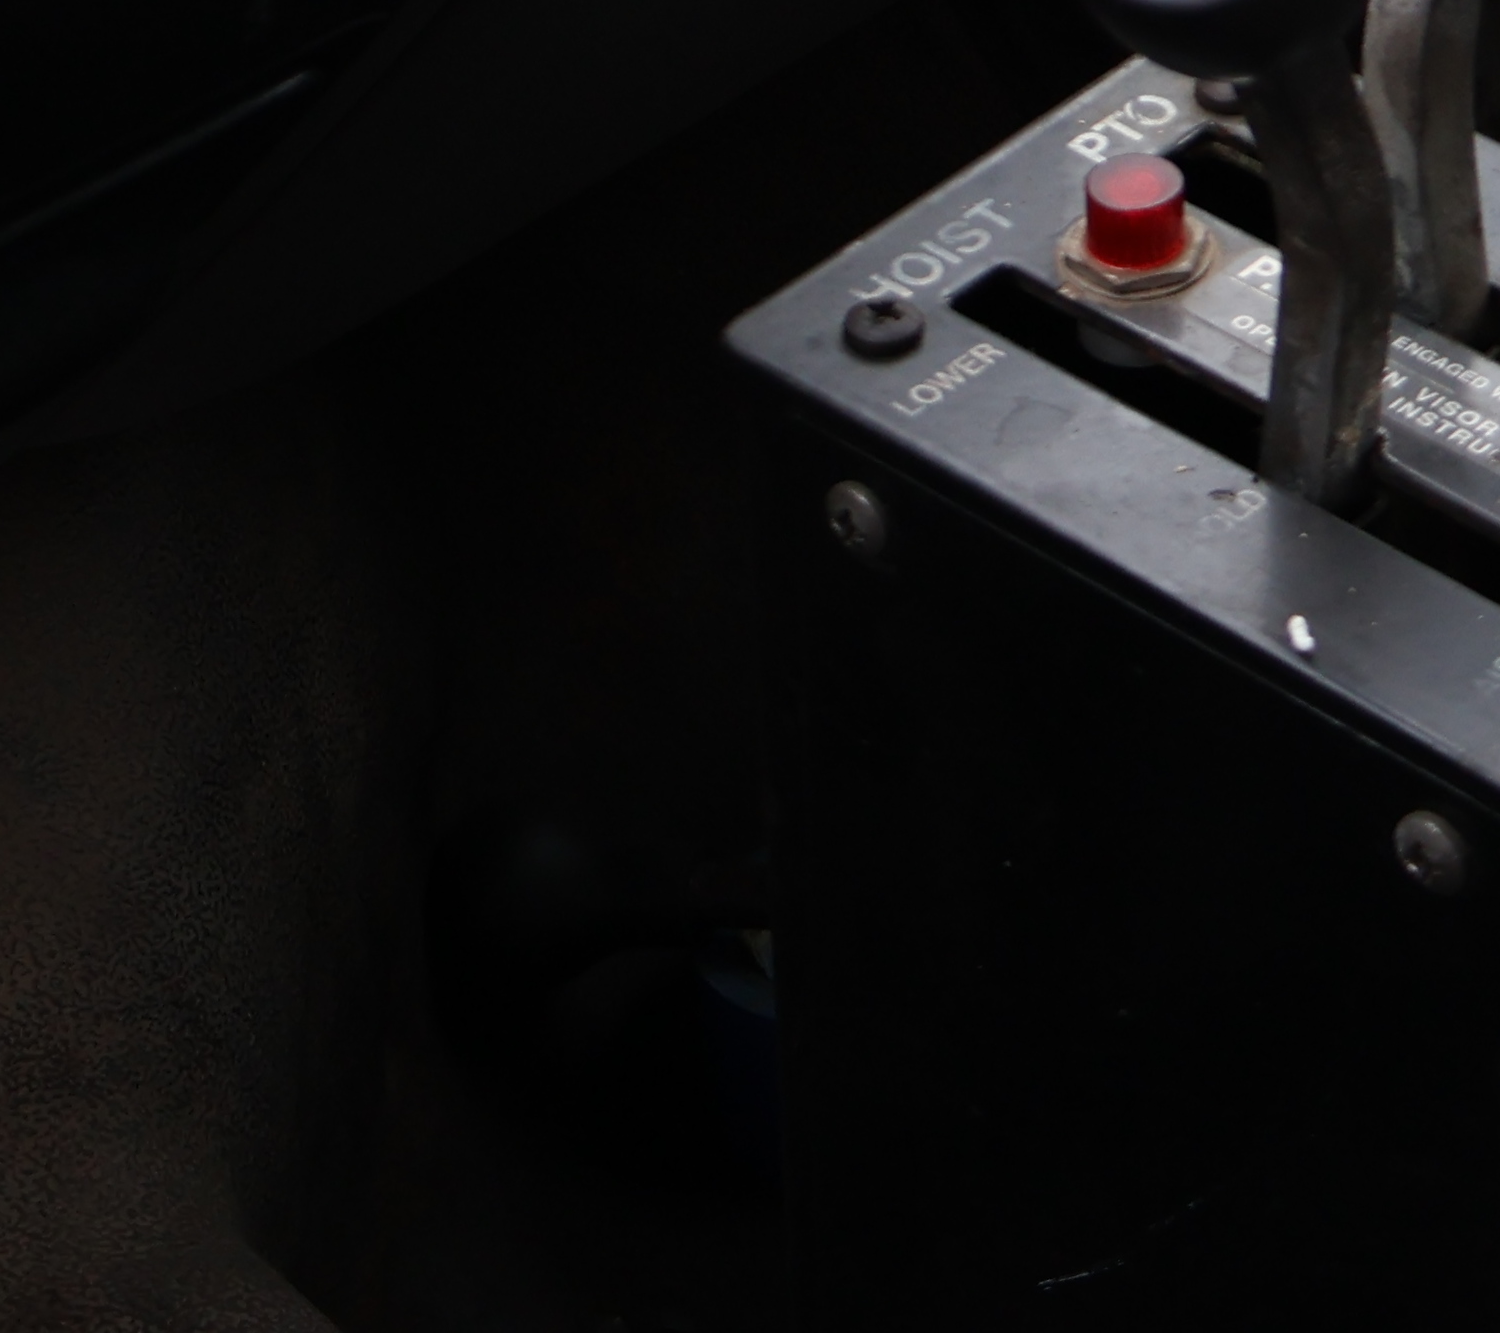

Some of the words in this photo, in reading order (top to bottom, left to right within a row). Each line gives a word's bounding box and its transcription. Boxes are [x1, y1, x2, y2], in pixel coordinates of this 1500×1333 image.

[1065, 93, 1178, 163] PTO
[847, 196, 1016, 301] HOIST
[889, 343, 1008, 417] LOWER
[1390, 335, 1490, 390] ENGAGED
[1414, 385, 1500, 438] VISOR
